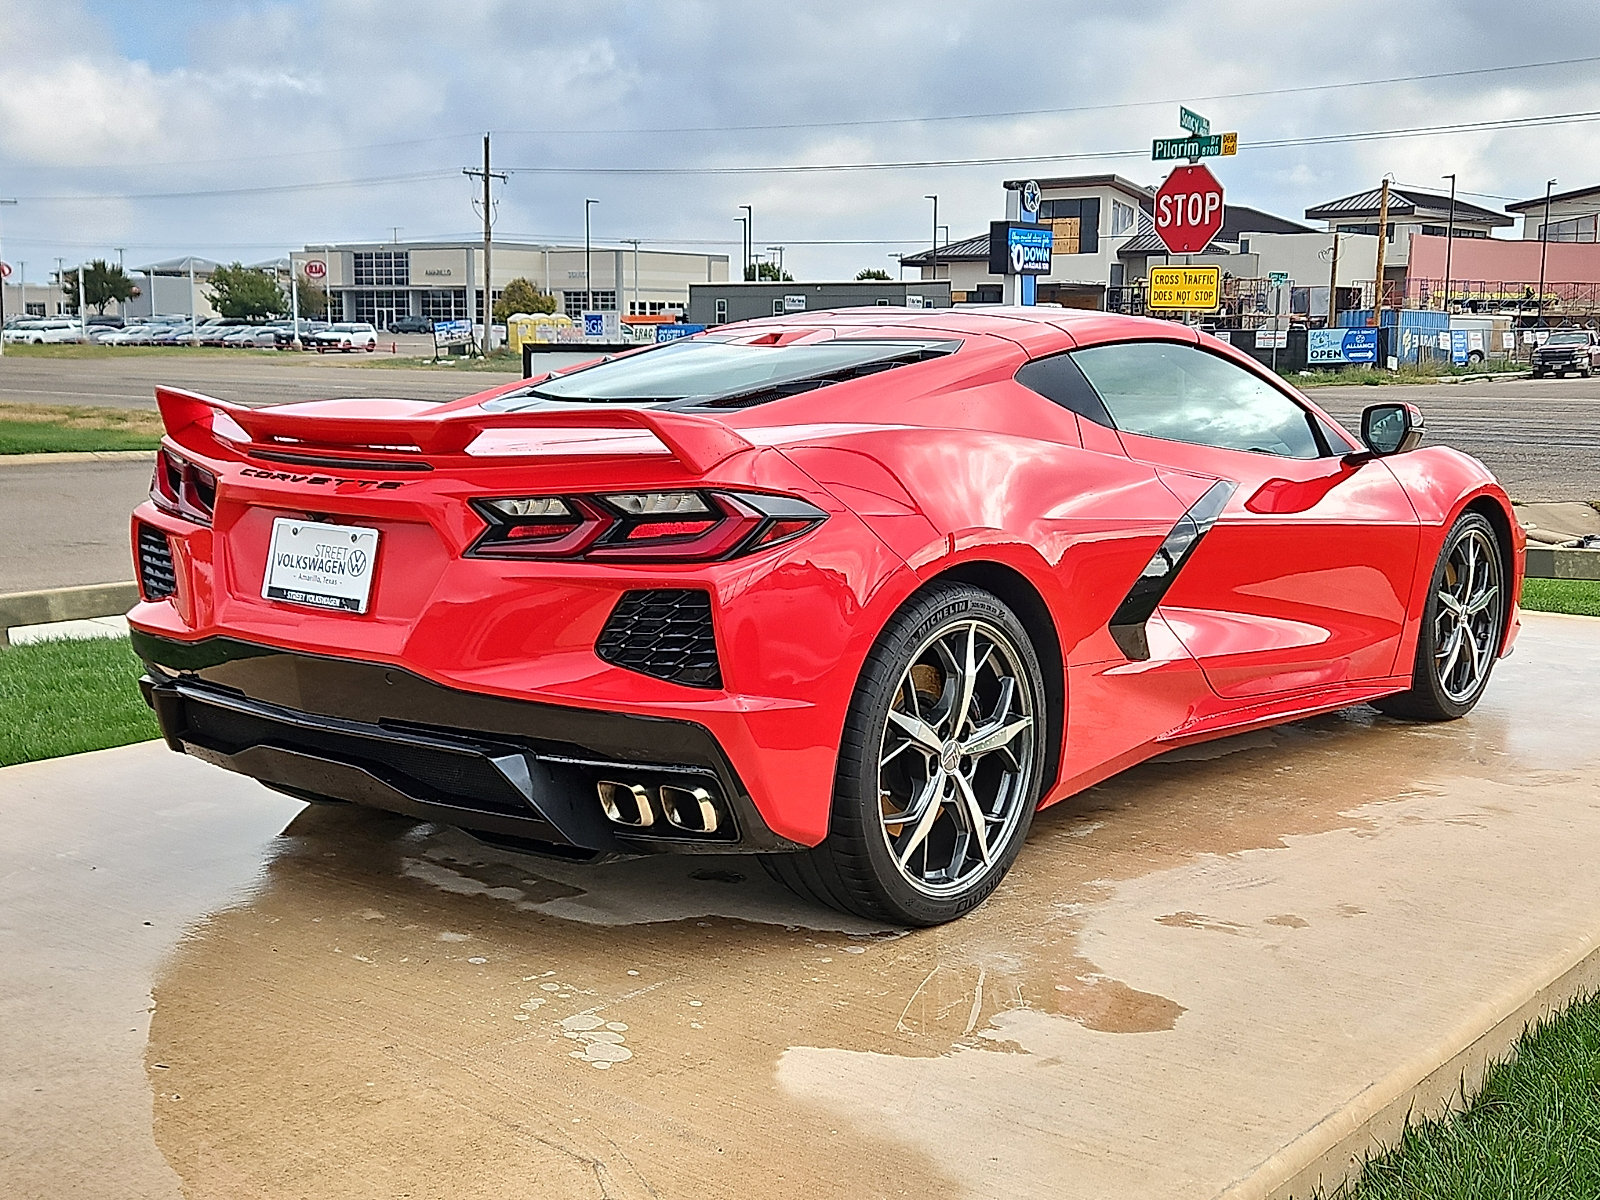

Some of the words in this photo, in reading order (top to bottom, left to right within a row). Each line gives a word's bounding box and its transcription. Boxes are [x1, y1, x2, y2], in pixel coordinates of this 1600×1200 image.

[1223, 134, 1237, 144] Dead
[1155, 140, 1200, 159] Pilgrim
[1211, 136, 1219, 145] Dr
[1201, 145, 1219, 156] 8700
[1224, 143, 1235, 154] End
[1157, 191, 1220, 228] STOP
[1024, 247, 1049, 262] DOWN
[1154, 274, 1180, 285] CROSS
[1184, 273, 1215, 286] TRAFFIC
[1153, 290, 1173, 302] DOES
[1176, 290, 1191, 302] NOT
[1194, 290, 1214, 302] STOP
[1310, 350, 1341, 359] OPEN
[239, 468, 405, 490] CORVETTE
[315, 544, 349, 561] STREET
[277, 552, 347, 575] VOLKSWAGEN
[323, 576, 337, 585] Texas
[917, 601, 967, 637] MICHELIN
